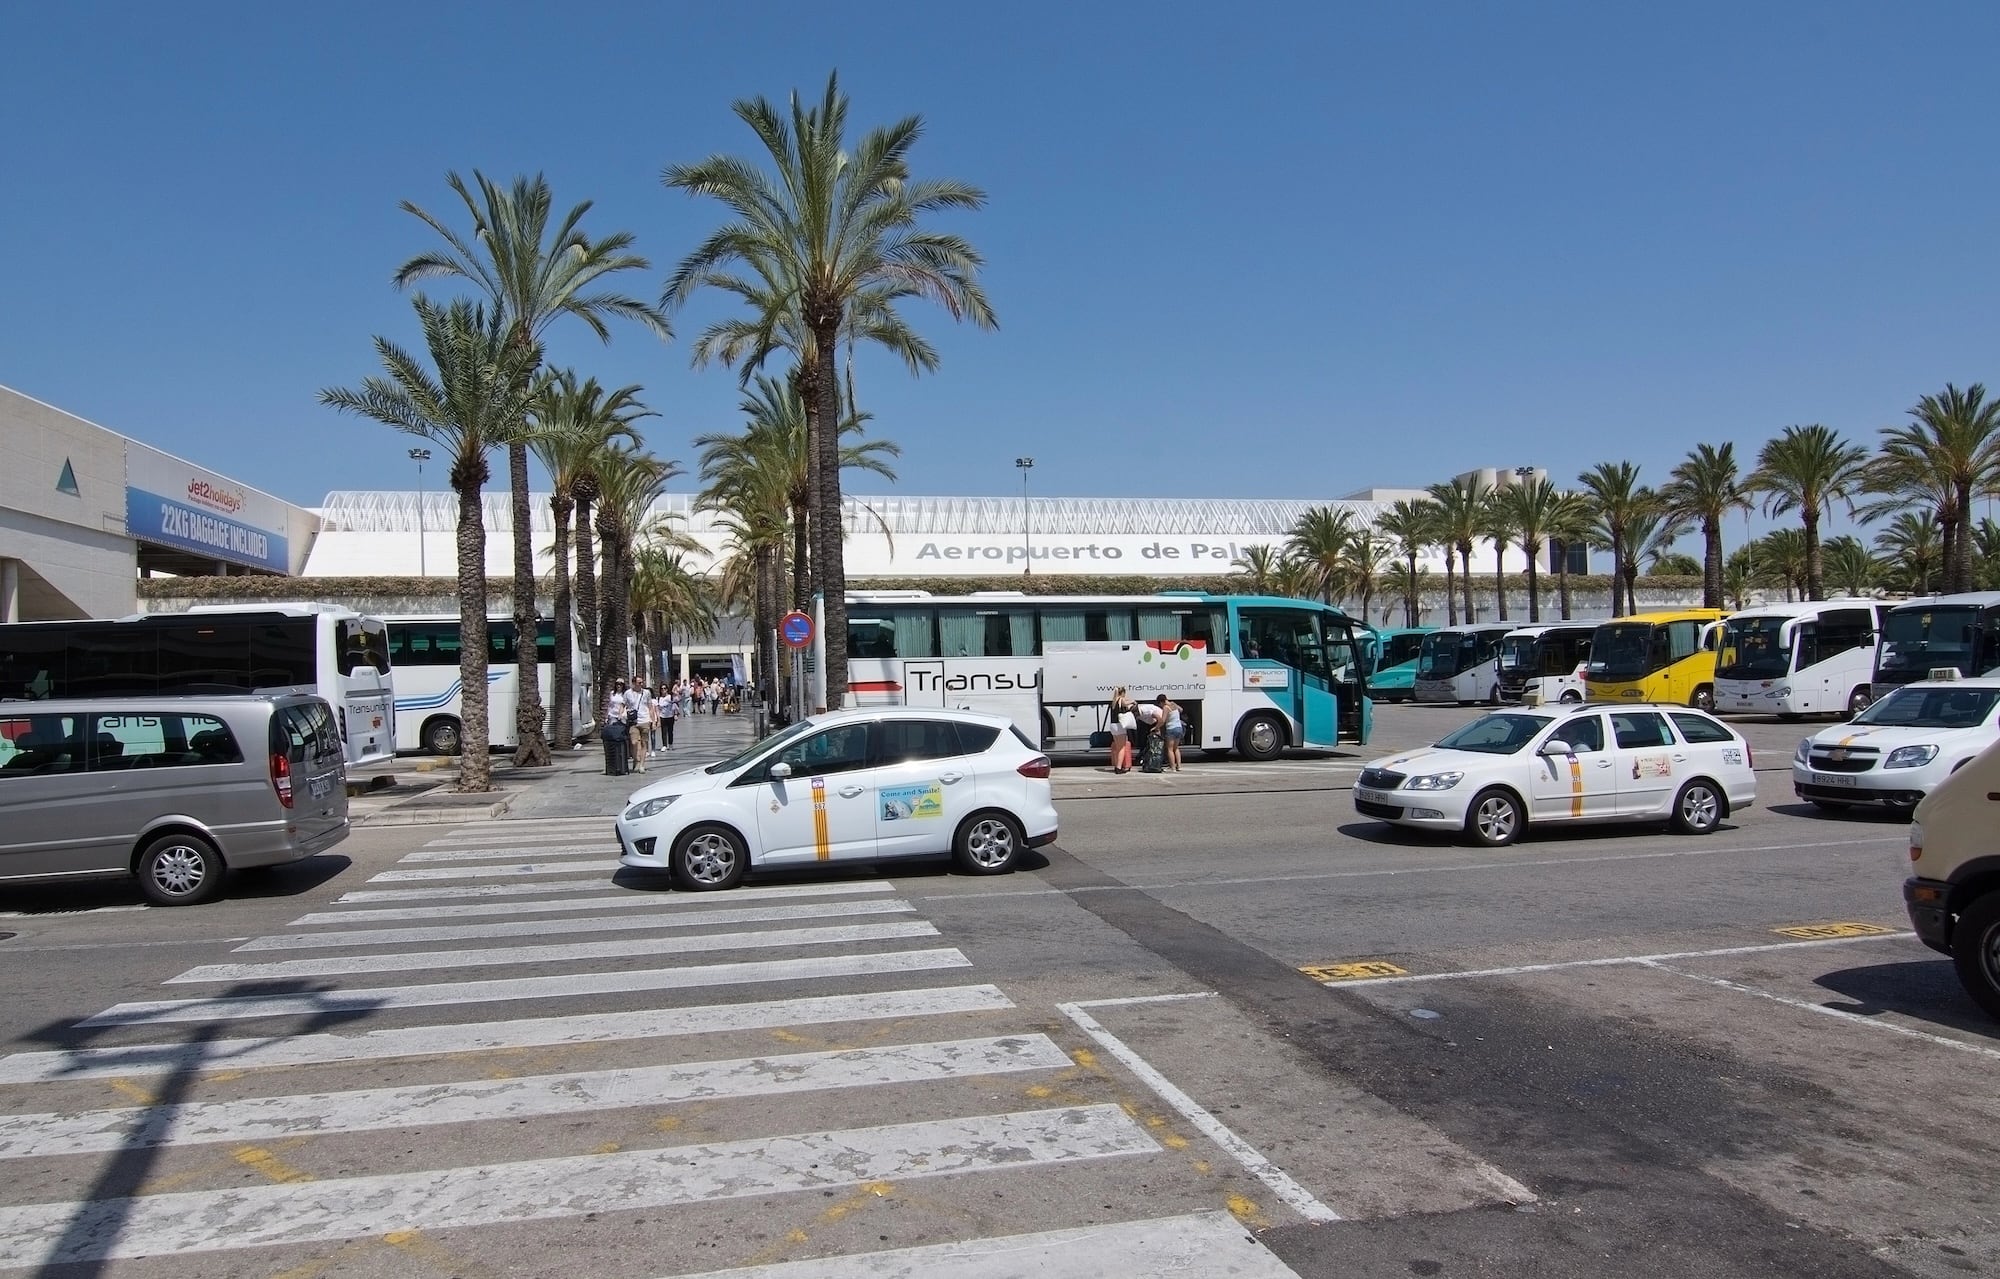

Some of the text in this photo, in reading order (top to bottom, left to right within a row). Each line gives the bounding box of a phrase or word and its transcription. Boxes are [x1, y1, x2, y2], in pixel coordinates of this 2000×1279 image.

[161, 503, 189, 538] 22KG
[190, 511, 230, 549] BAGGAGE
[230, 525, 268, 560] INCLUDED
[915, 543, 1123, 564] Aeropuerto
[1141, 542, 1180, 559] de
[909, 671, 1038, 691] Transu
[1096, 683, 1206, 691] wwtransunion.info
[348, 702, 390, 715] Transunion
[1816, 775, 1835, 784] 8924
[917, 787, 940, 795] Smile!
